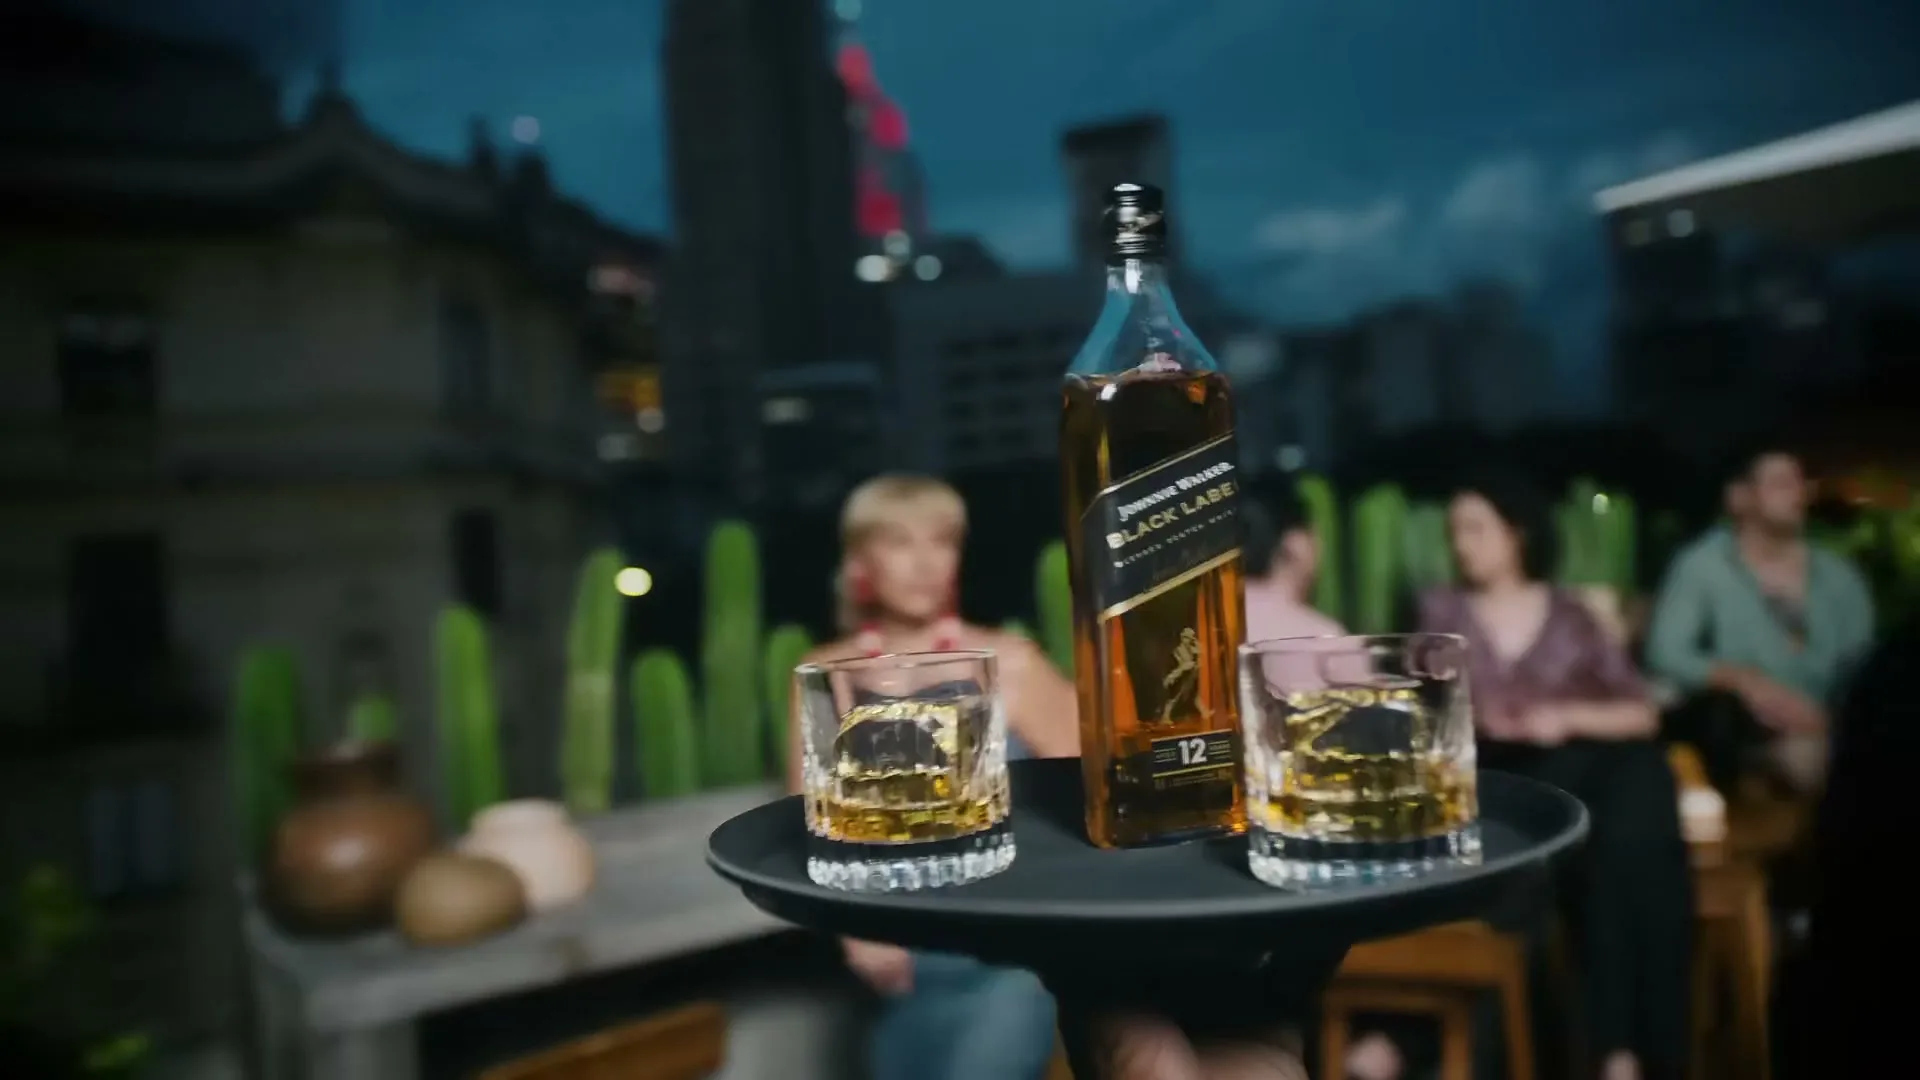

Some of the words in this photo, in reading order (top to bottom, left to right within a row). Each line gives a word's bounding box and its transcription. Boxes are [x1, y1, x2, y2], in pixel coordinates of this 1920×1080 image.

[1117, 485, 1179, 522] JOHNNIE
[1106, 507, 1180, 549] BLACK
[1178, 738, 1206, 765] 12
